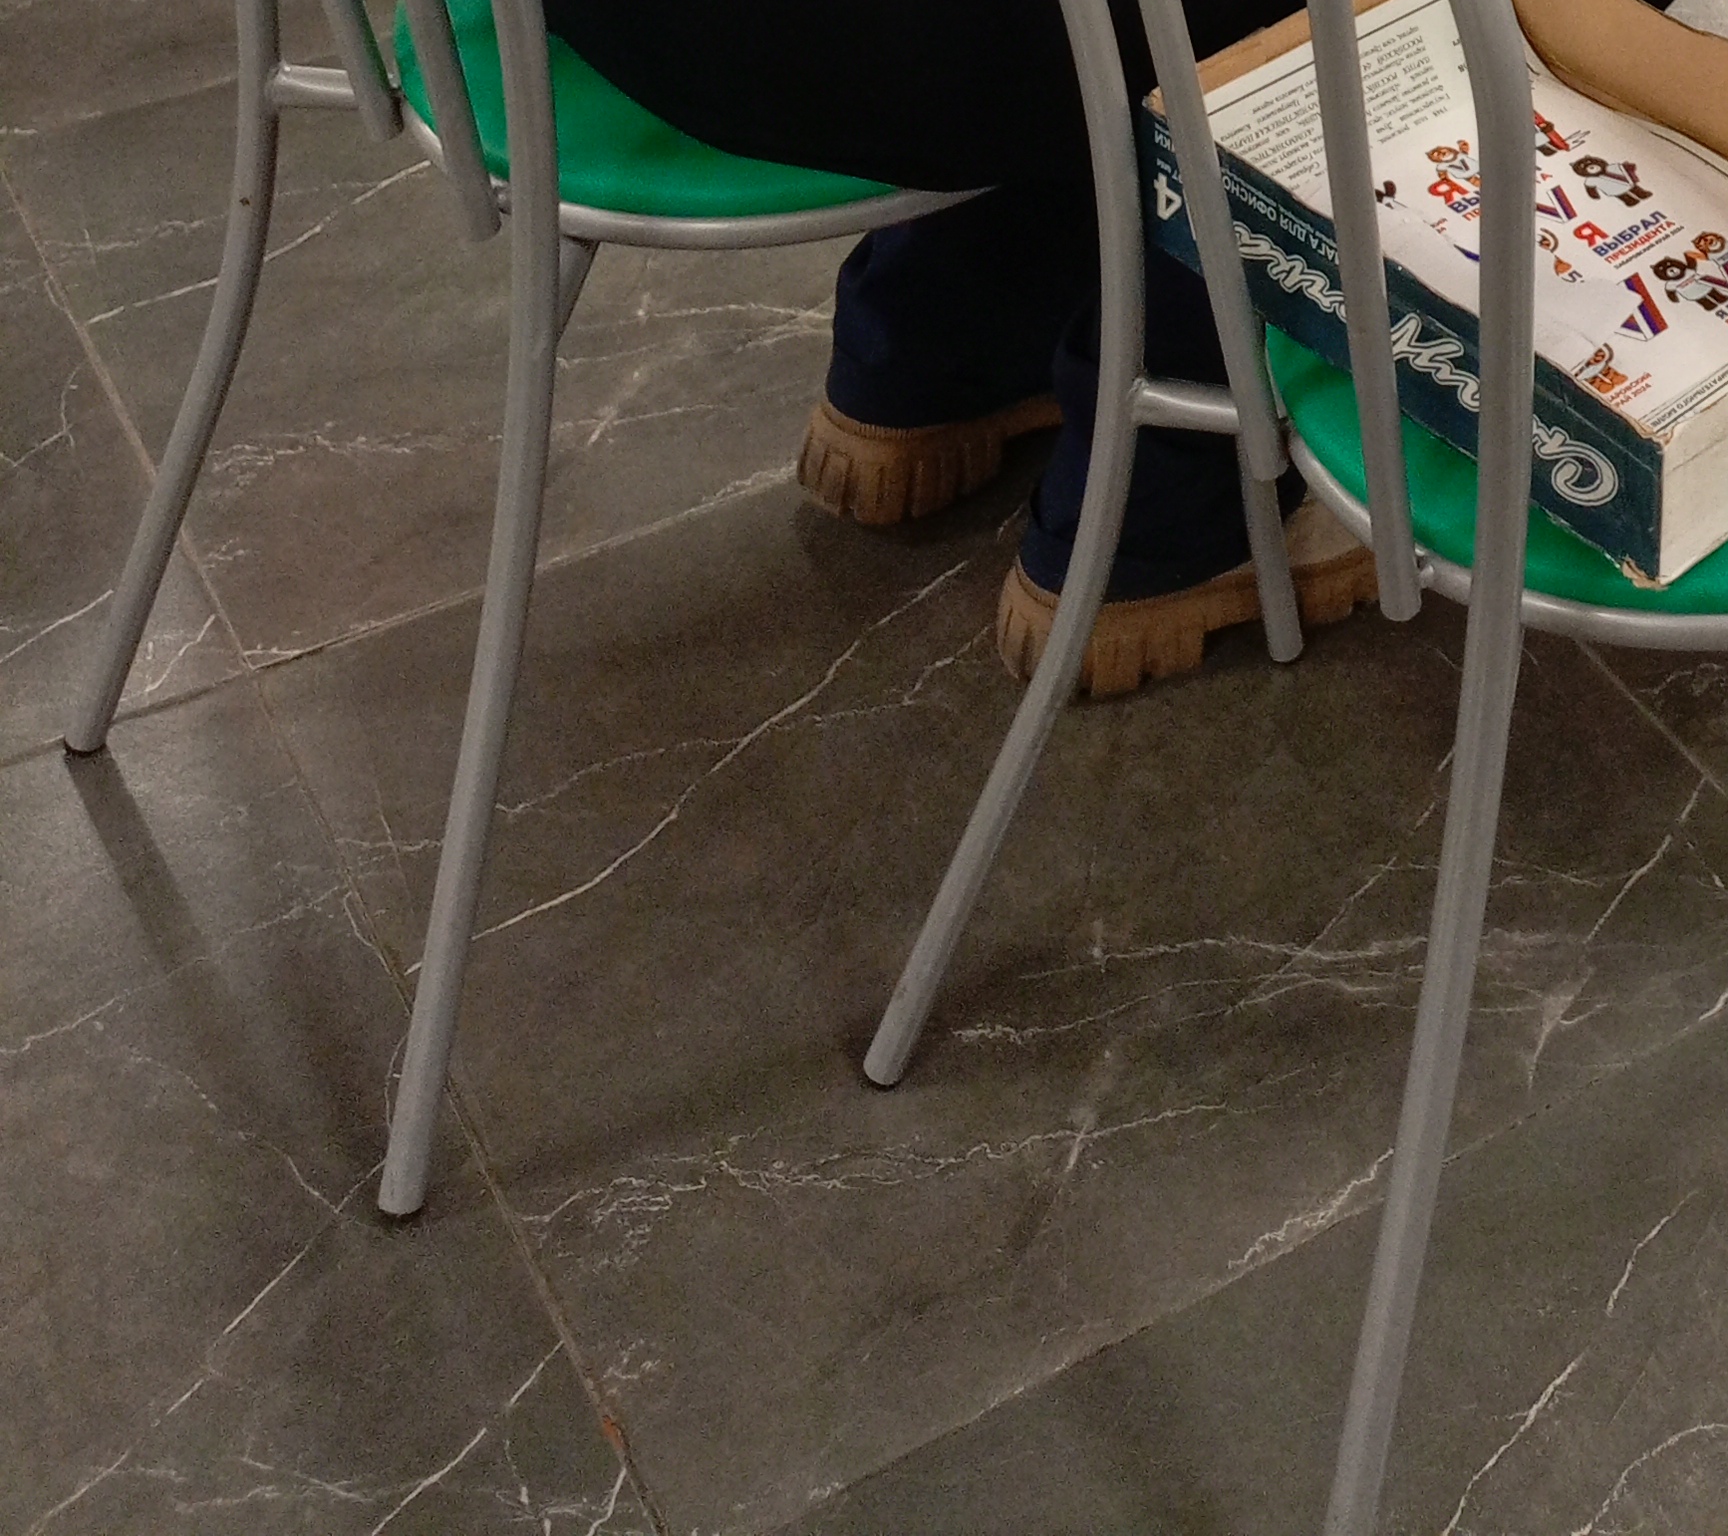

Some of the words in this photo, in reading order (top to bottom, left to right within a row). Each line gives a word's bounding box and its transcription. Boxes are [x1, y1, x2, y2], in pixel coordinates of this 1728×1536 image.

[1153, 172, 1184, 222] 4
[1223, 175, 1277, 221] ОФИСНО
[1428, 177, 1469, 205] Я
[1279, 219, 1309, 243] ДЛЯ
[1573, 220, 1609, 247] Я
[1592, 210, 1668, 258] ВЫБРАЛ
[1604, 219, 1676, 264] ПРЕЗИДЕНТА
[1715, 308, 1728, 320] Я
